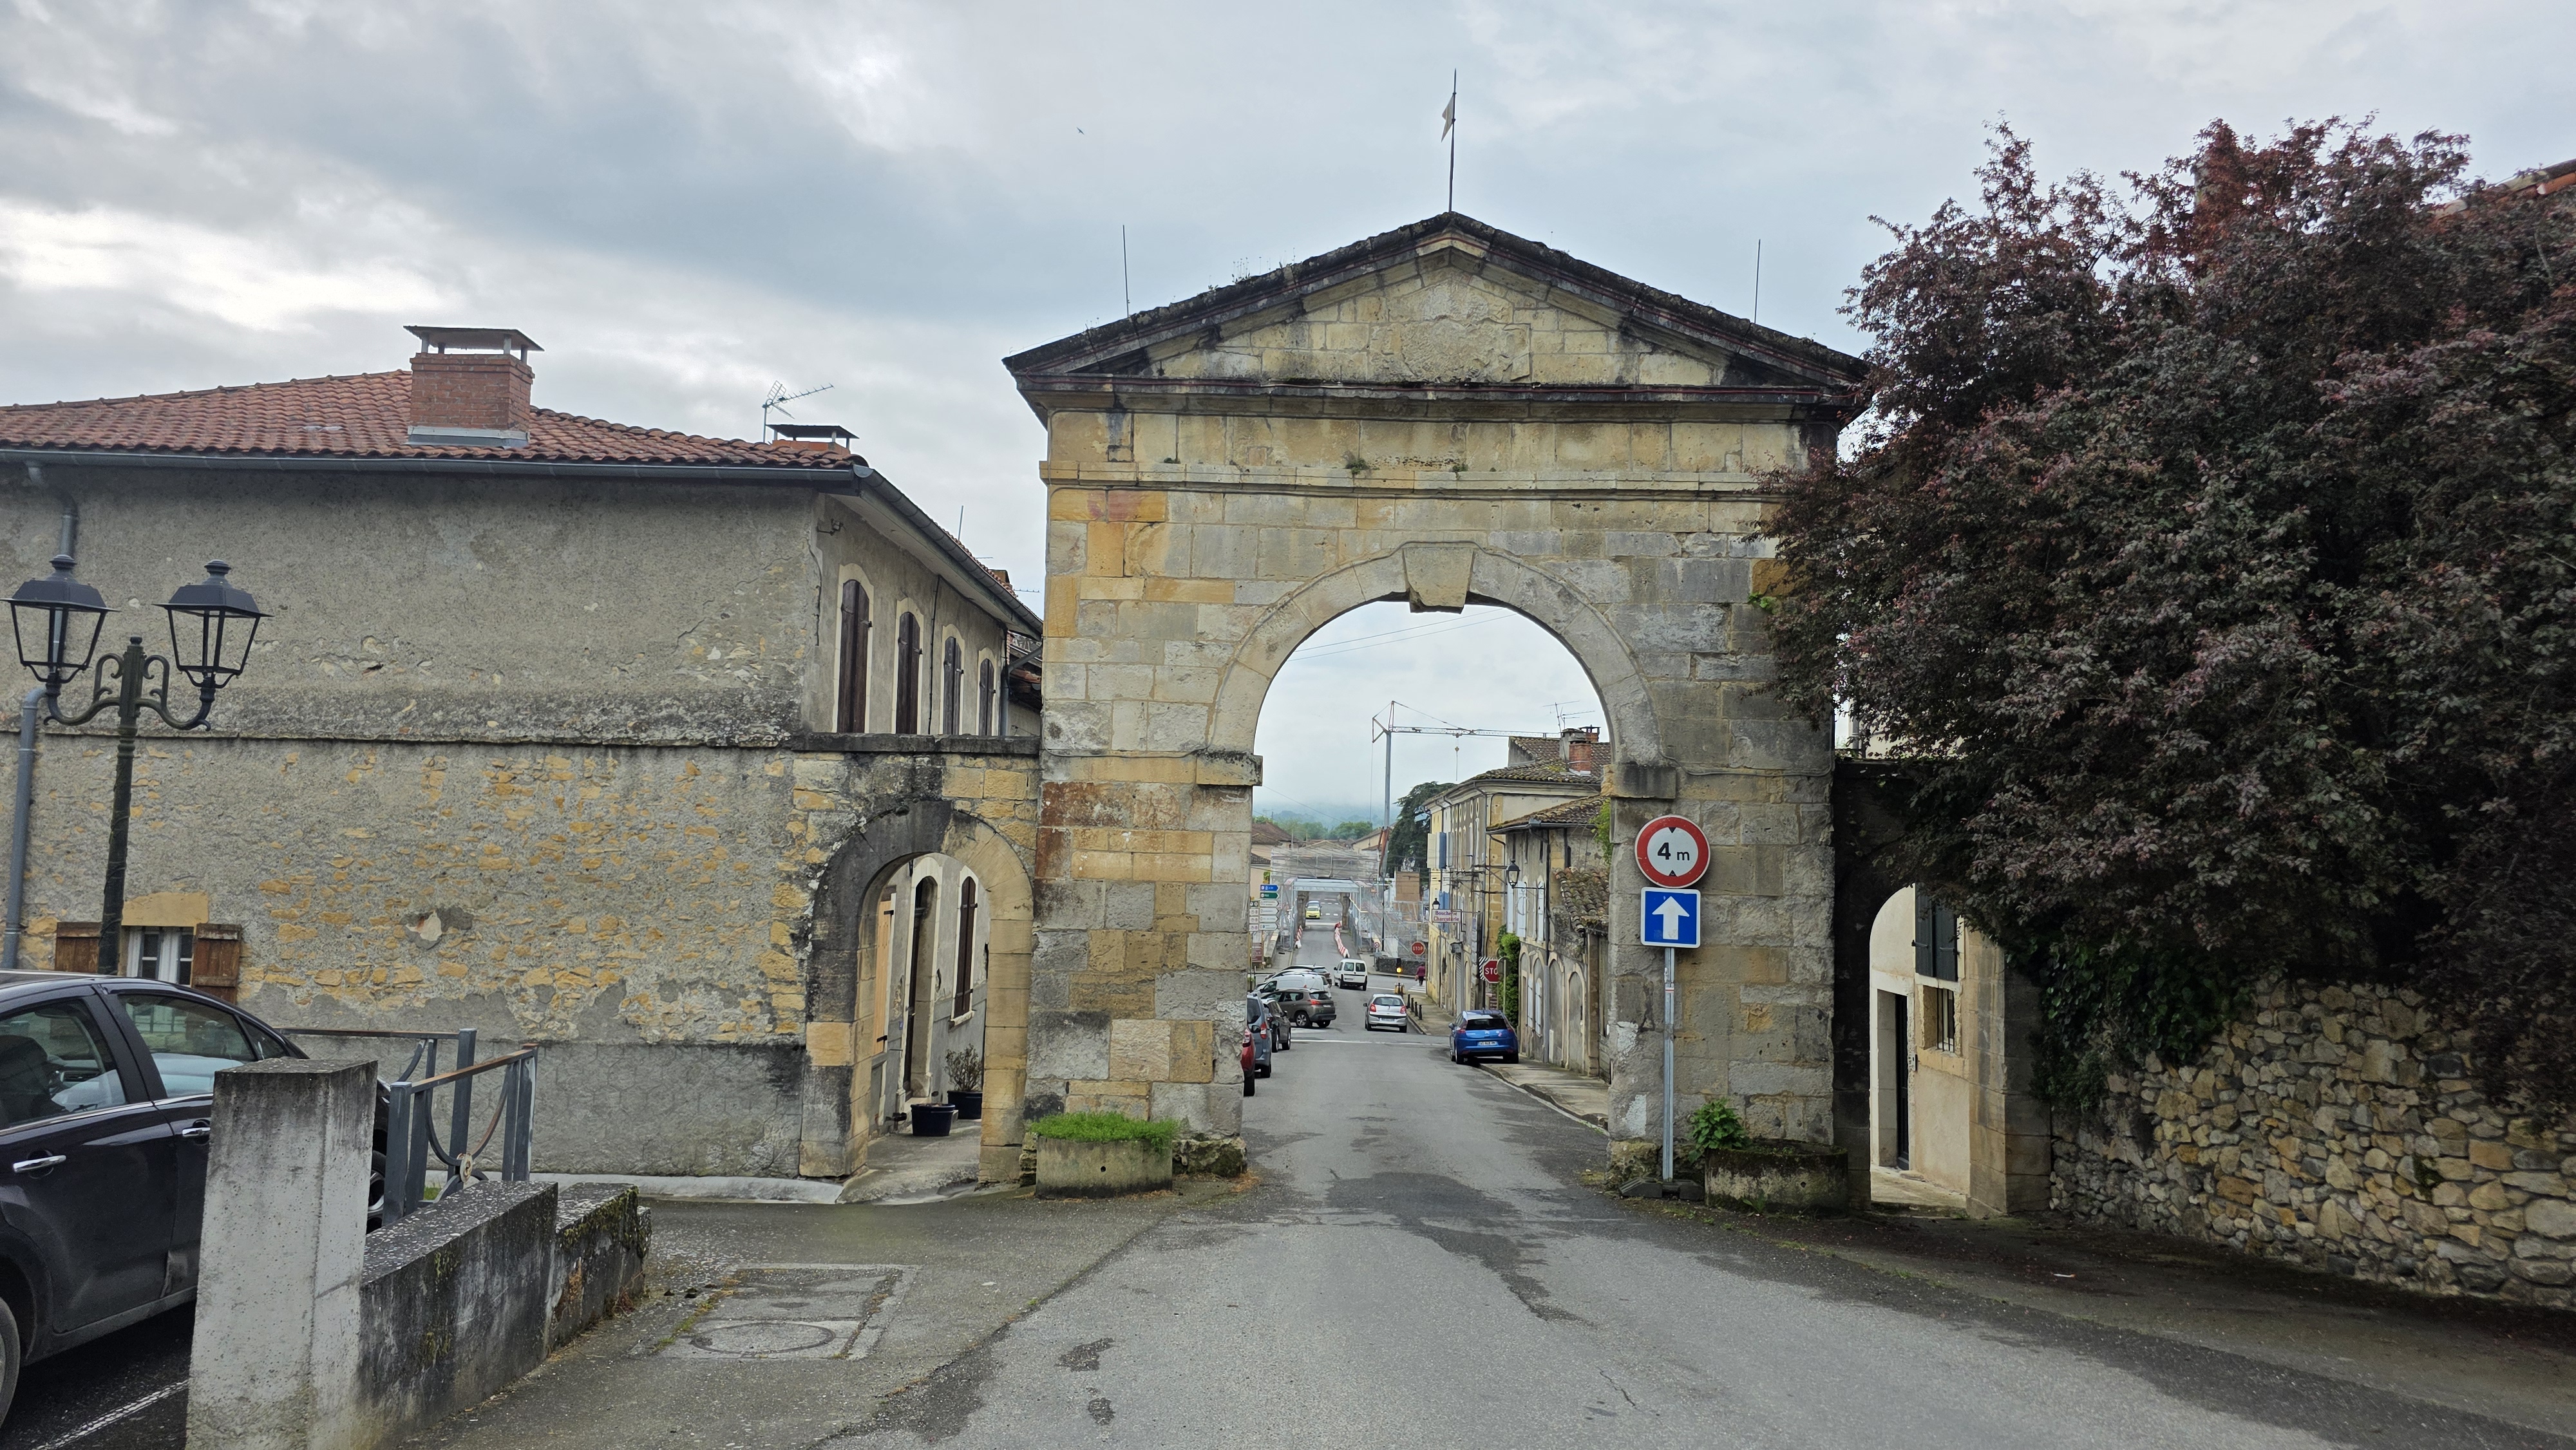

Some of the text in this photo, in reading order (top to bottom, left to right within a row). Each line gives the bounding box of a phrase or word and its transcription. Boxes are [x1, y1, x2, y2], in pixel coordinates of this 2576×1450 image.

[1657, 842, 1690, 861] 4 m
[1484, 967, 1499, 975] STO
